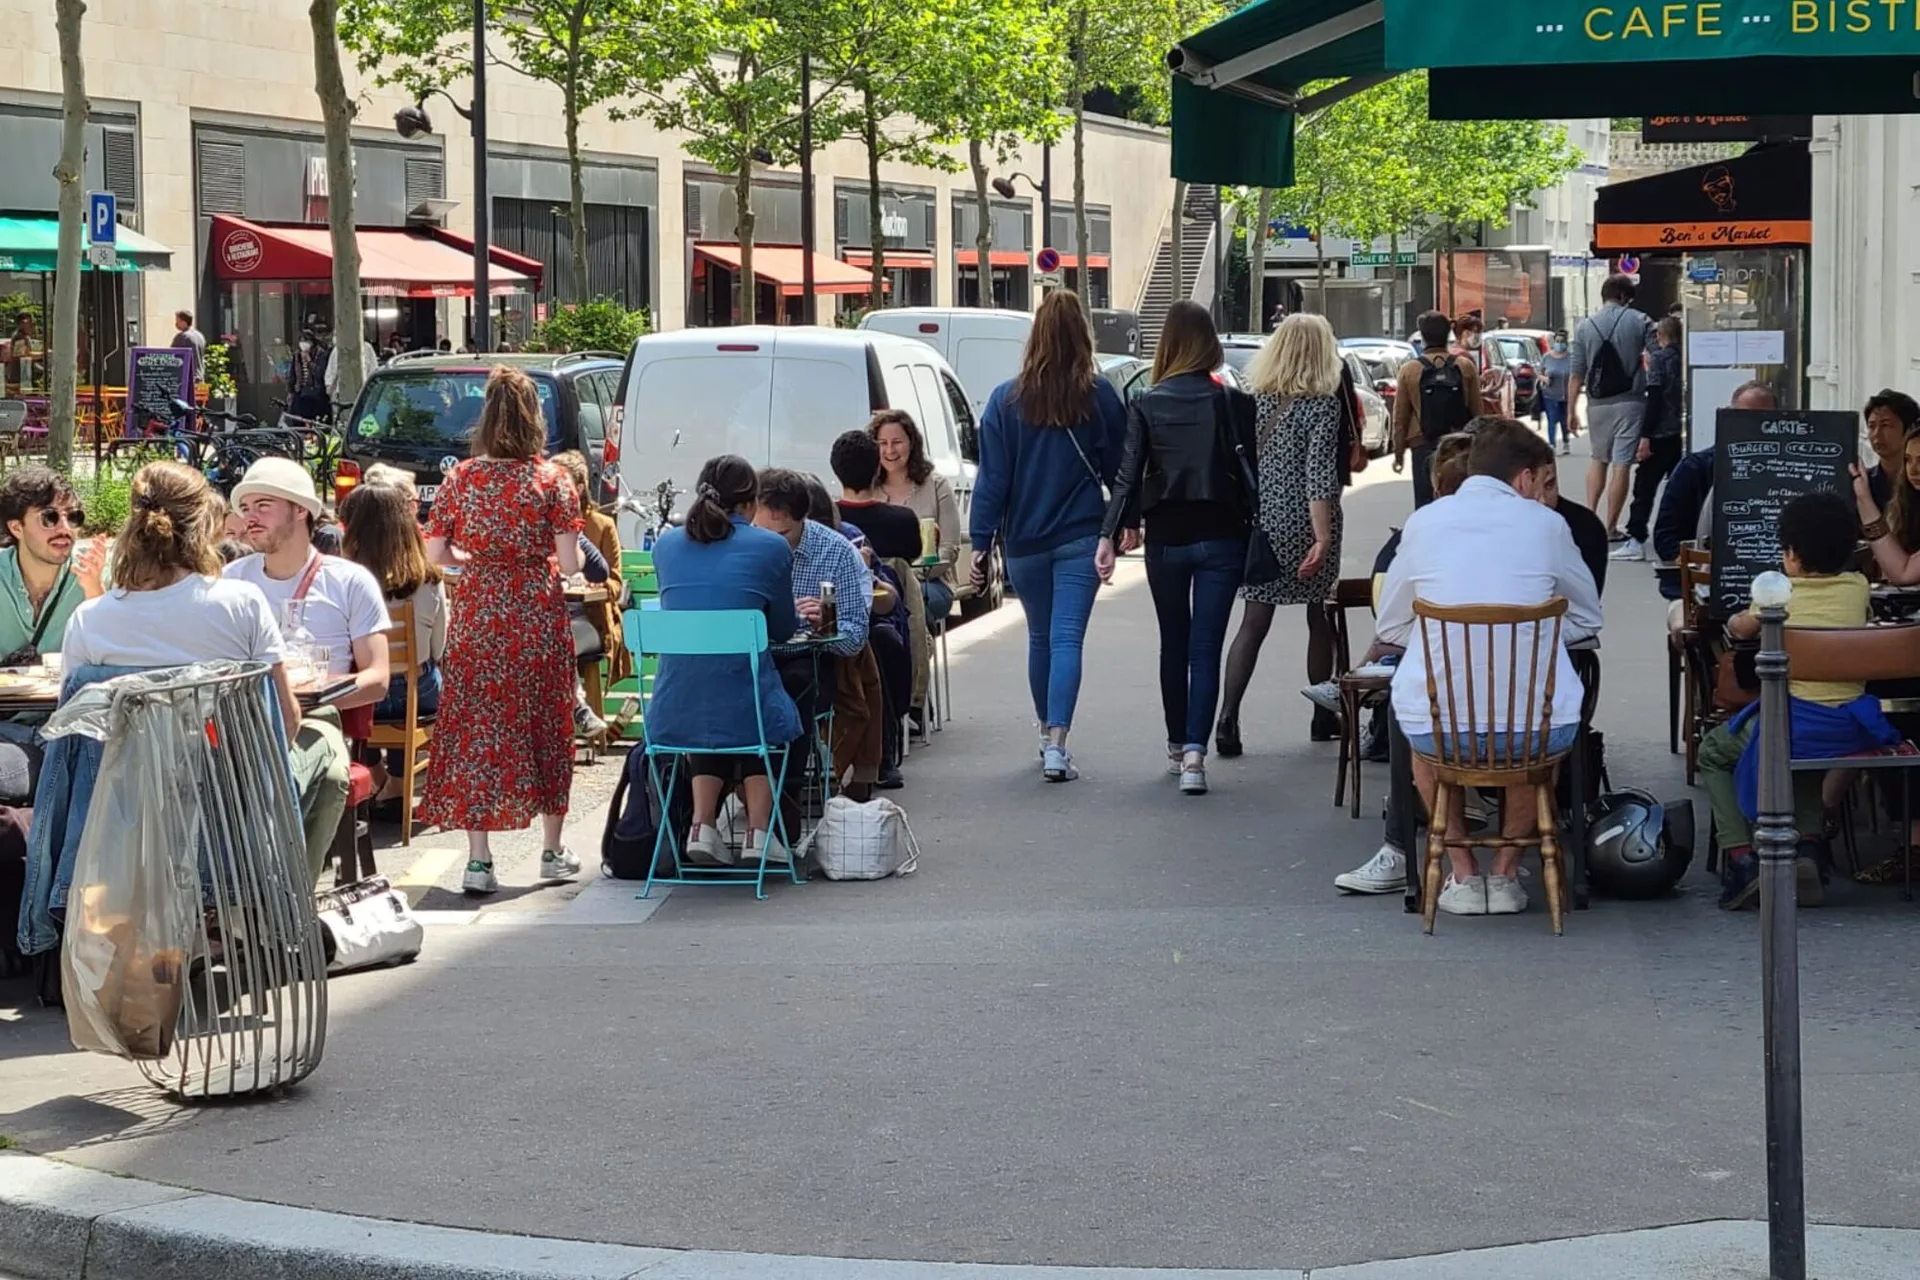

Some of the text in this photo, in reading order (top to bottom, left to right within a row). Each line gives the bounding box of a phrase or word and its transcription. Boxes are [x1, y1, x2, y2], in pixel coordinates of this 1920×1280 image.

[1583, 3, 1723, 41] CAFE
[96, 202, 109, 235] P
[1711, 225, 1772, 242] Market
[1401, 254, 1415, 262] VIE
[1731, 443, 1777, 454] BURGERS
